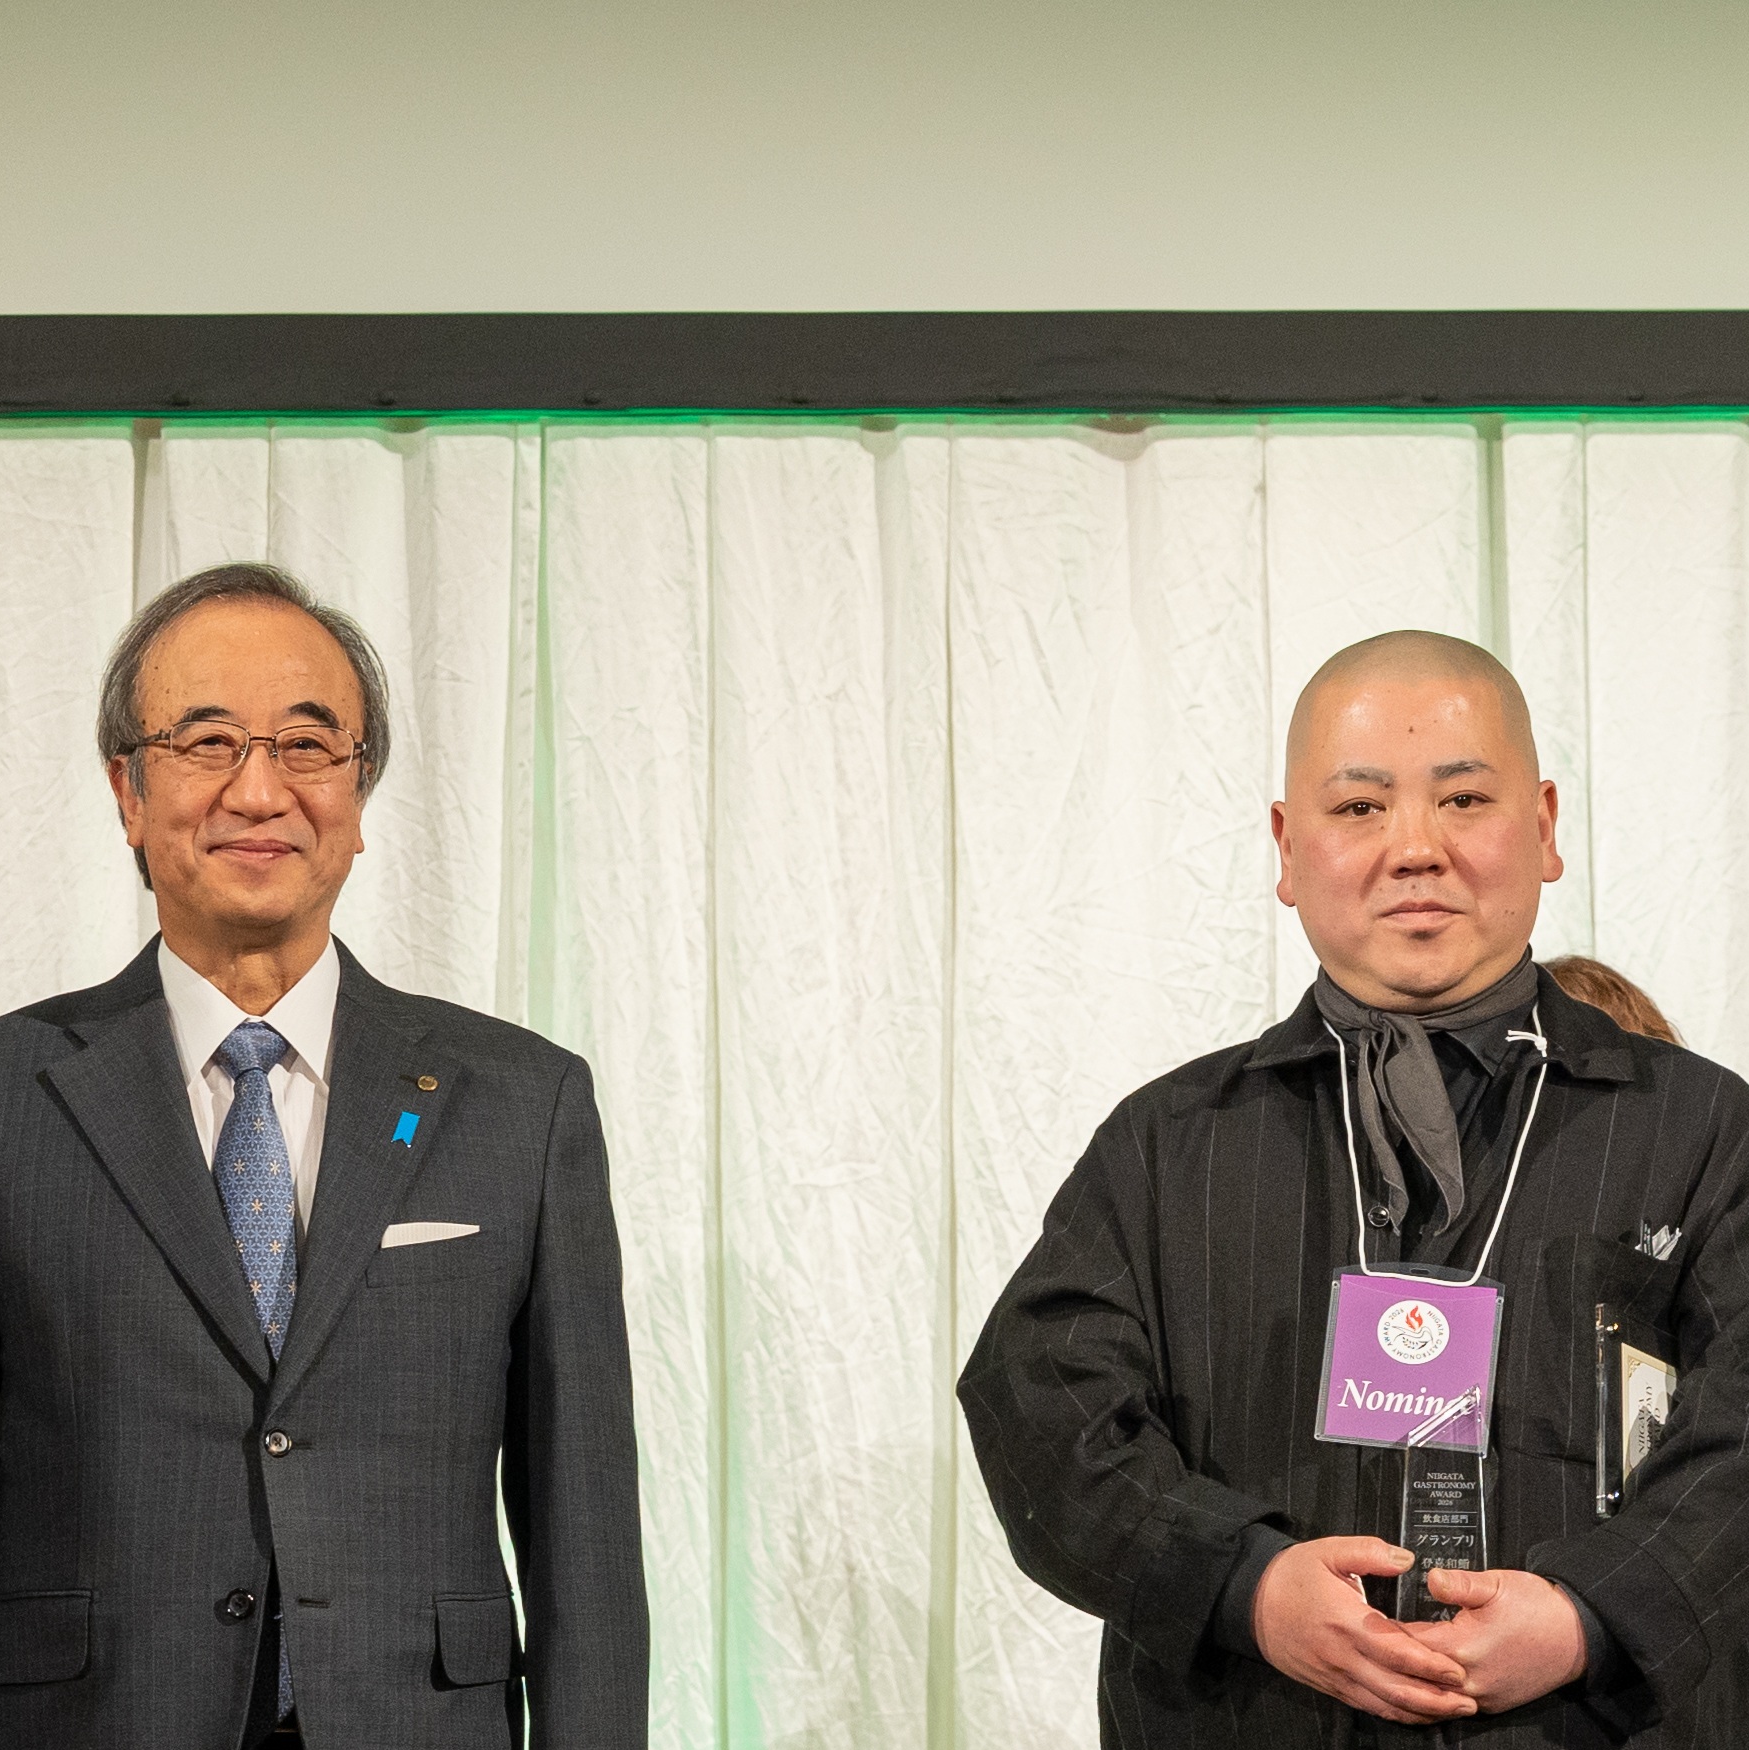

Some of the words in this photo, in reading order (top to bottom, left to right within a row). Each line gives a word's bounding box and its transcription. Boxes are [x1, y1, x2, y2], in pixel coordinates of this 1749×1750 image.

[1337, 1378, 1458, 1416] Nomin
[1426, 1472, 1464, 1481] NIIGATA
[1413, 1481, 1476, 1490] GASTRONOMY
[1429, 1490, 1463, 1499] AWARD
[1415, 1533, 1475, 1548] グランプリ
